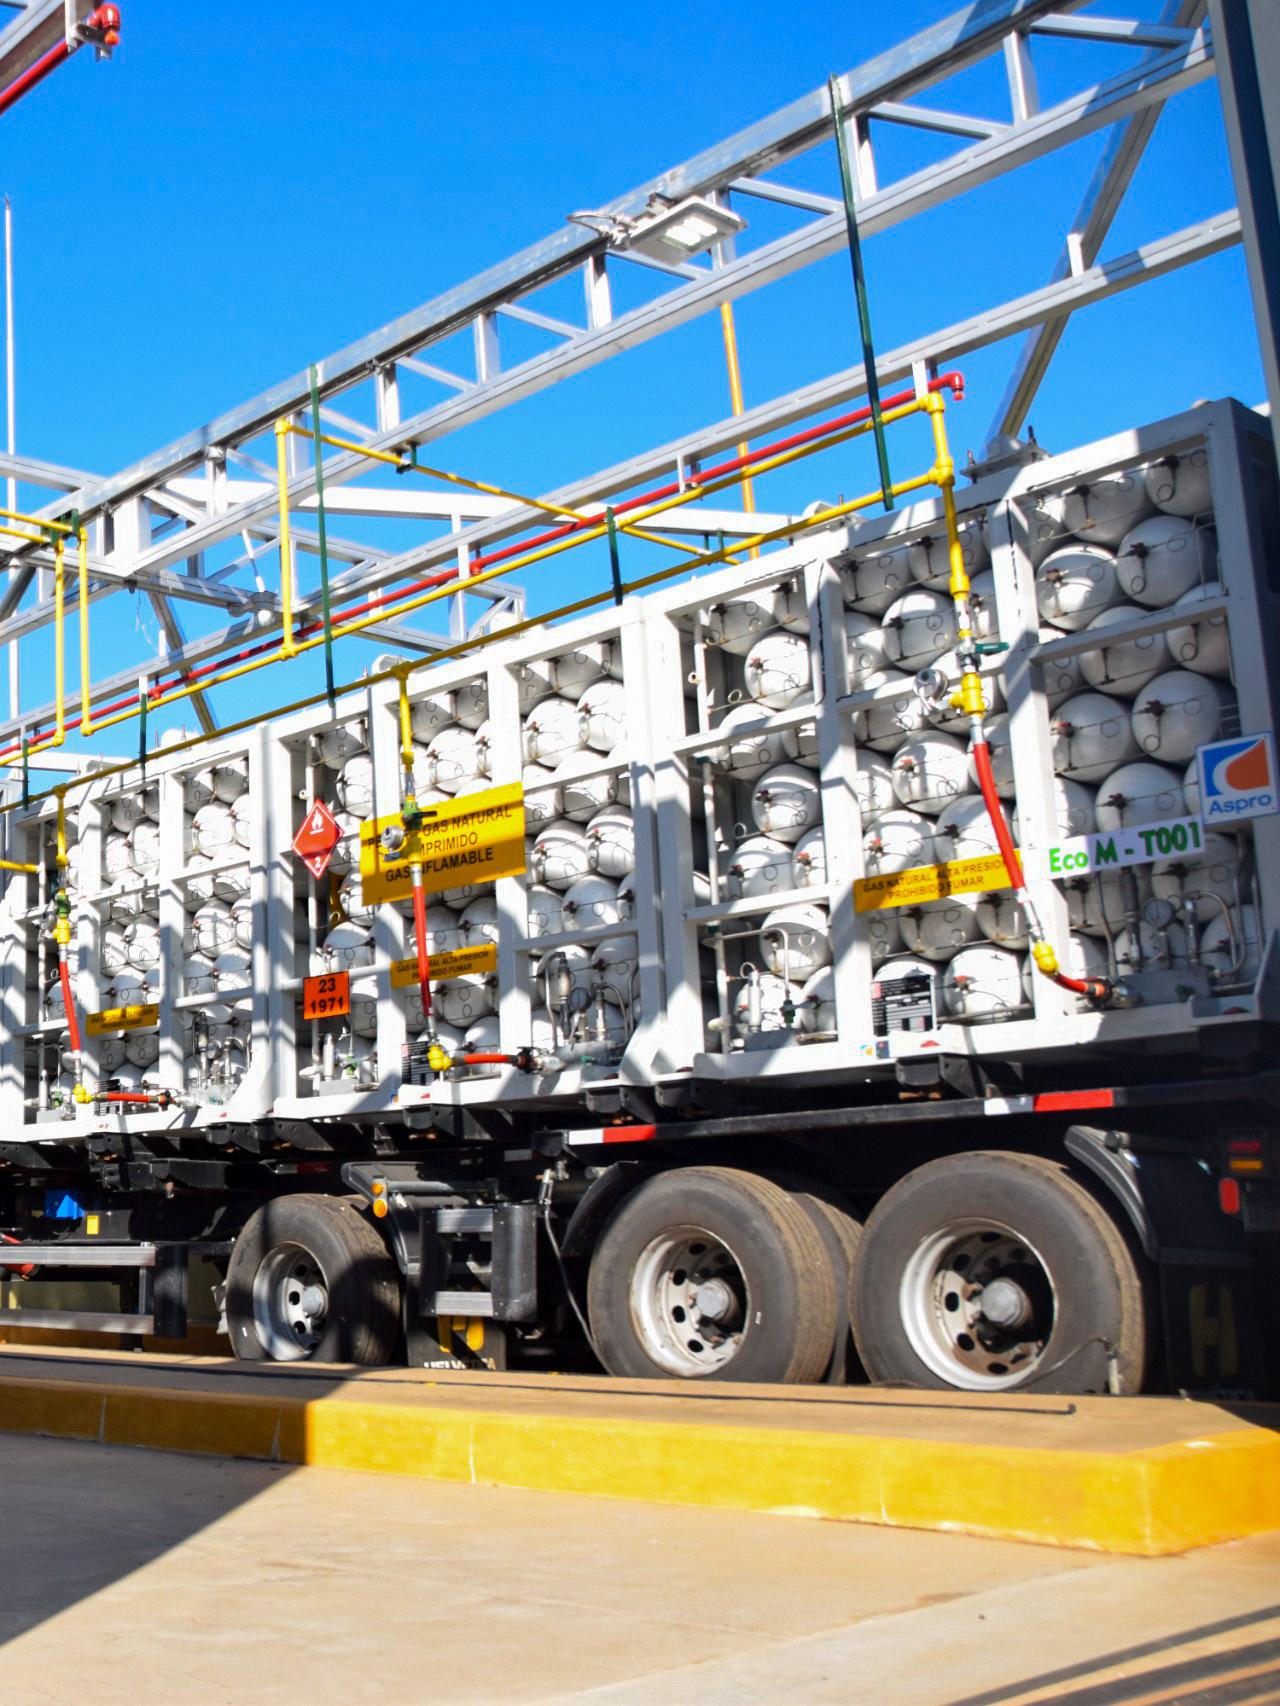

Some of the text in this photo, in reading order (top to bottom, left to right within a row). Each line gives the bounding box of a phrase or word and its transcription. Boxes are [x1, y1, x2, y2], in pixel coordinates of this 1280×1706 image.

[1209, 794, 1272, 815] Aspro
[422, 806, 513, 837] GAS NATURAL
[1049, 848, 1089, 872] Eco
[1095, 837, 1118, 866] M
[1139, 821, 1201, 857] T001
[385, 868, 410, 882] GAS
[864, 859, 1002, 893] GAS NATURAL ALTA PRESIO
[888, 876, 984, 899] PROHIBIDO FUMAR
[318, 978, 336, 993] 23
[310, 995, 344, 1013] 1971
